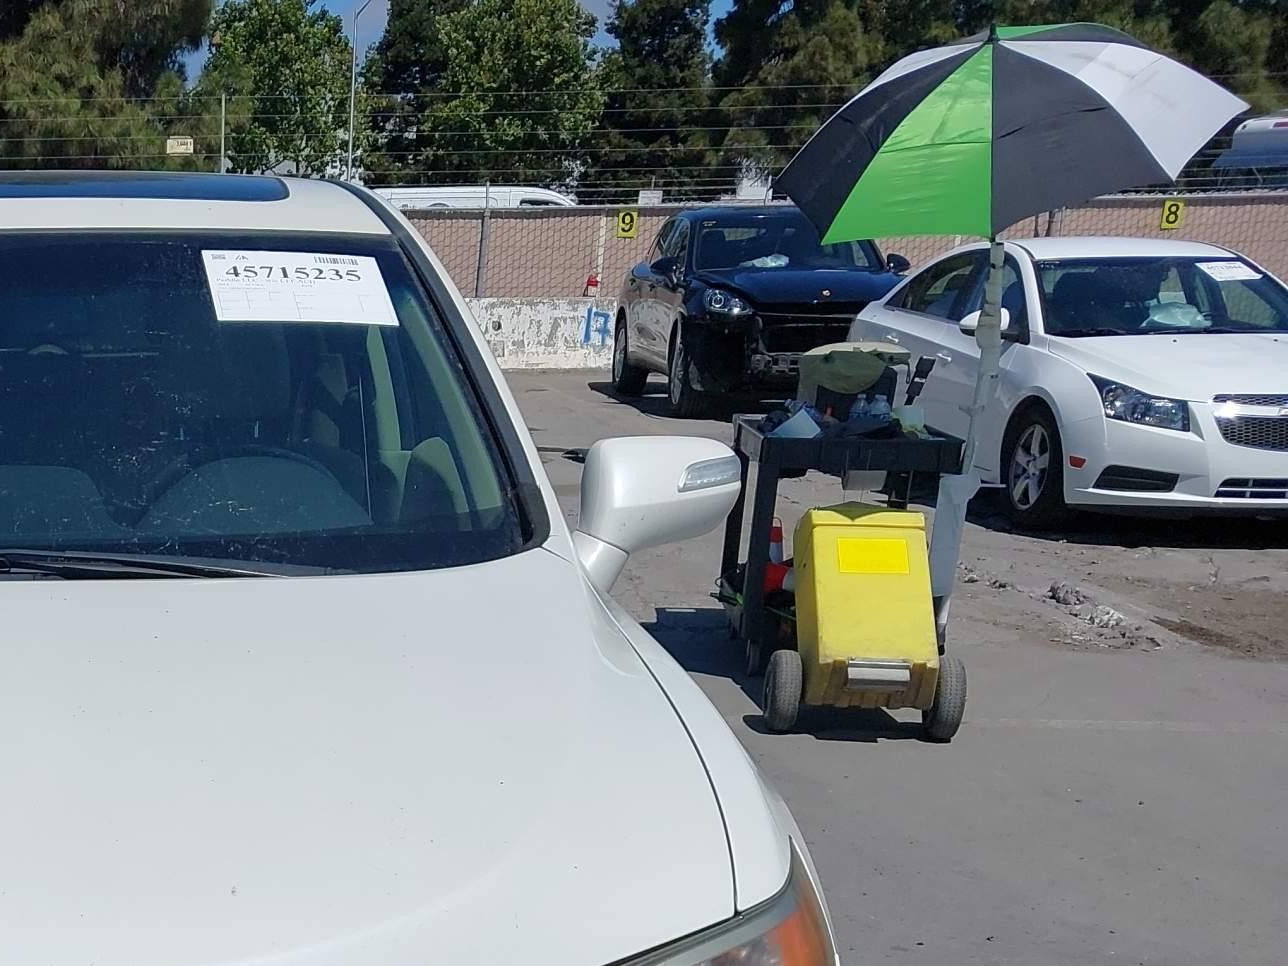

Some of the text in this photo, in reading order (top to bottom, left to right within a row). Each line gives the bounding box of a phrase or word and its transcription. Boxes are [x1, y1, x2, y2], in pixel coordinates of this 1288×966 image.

[621, 211, 635, 233] 9
[1165, 203, 1180, 224] 8
[225, 265, 361, 282] 45715235
